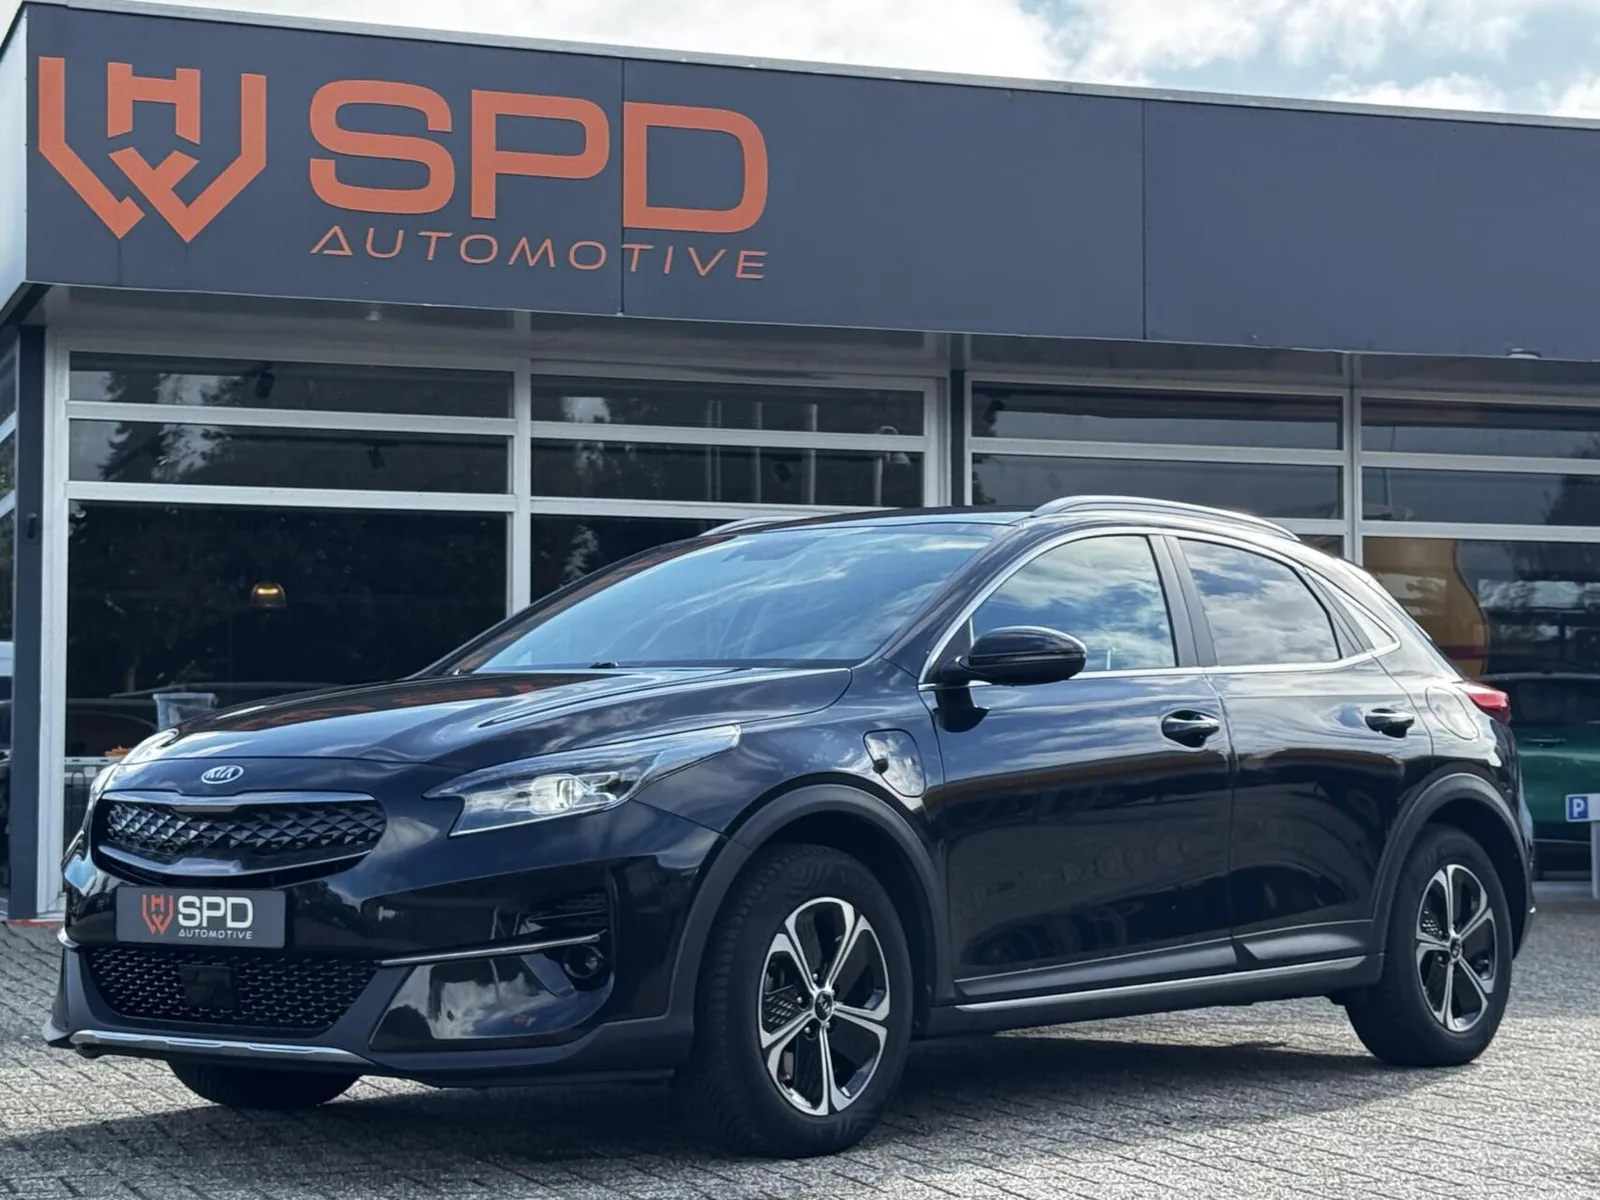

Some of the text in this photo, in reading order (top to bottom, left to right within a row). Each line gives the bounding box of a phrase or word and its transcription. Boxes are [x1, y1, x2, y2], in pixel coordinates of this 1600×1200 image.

[309, 79, 768, 233] SPD
[310, 224, 768, 281] AUTOMOTIVE
[203, 766, 238, 781] KIA
[1572, 798, 1586, 818] P
[177, 895, 254, 929] SPD
[178, 928, 253, 940] AUTOMOTIVE
